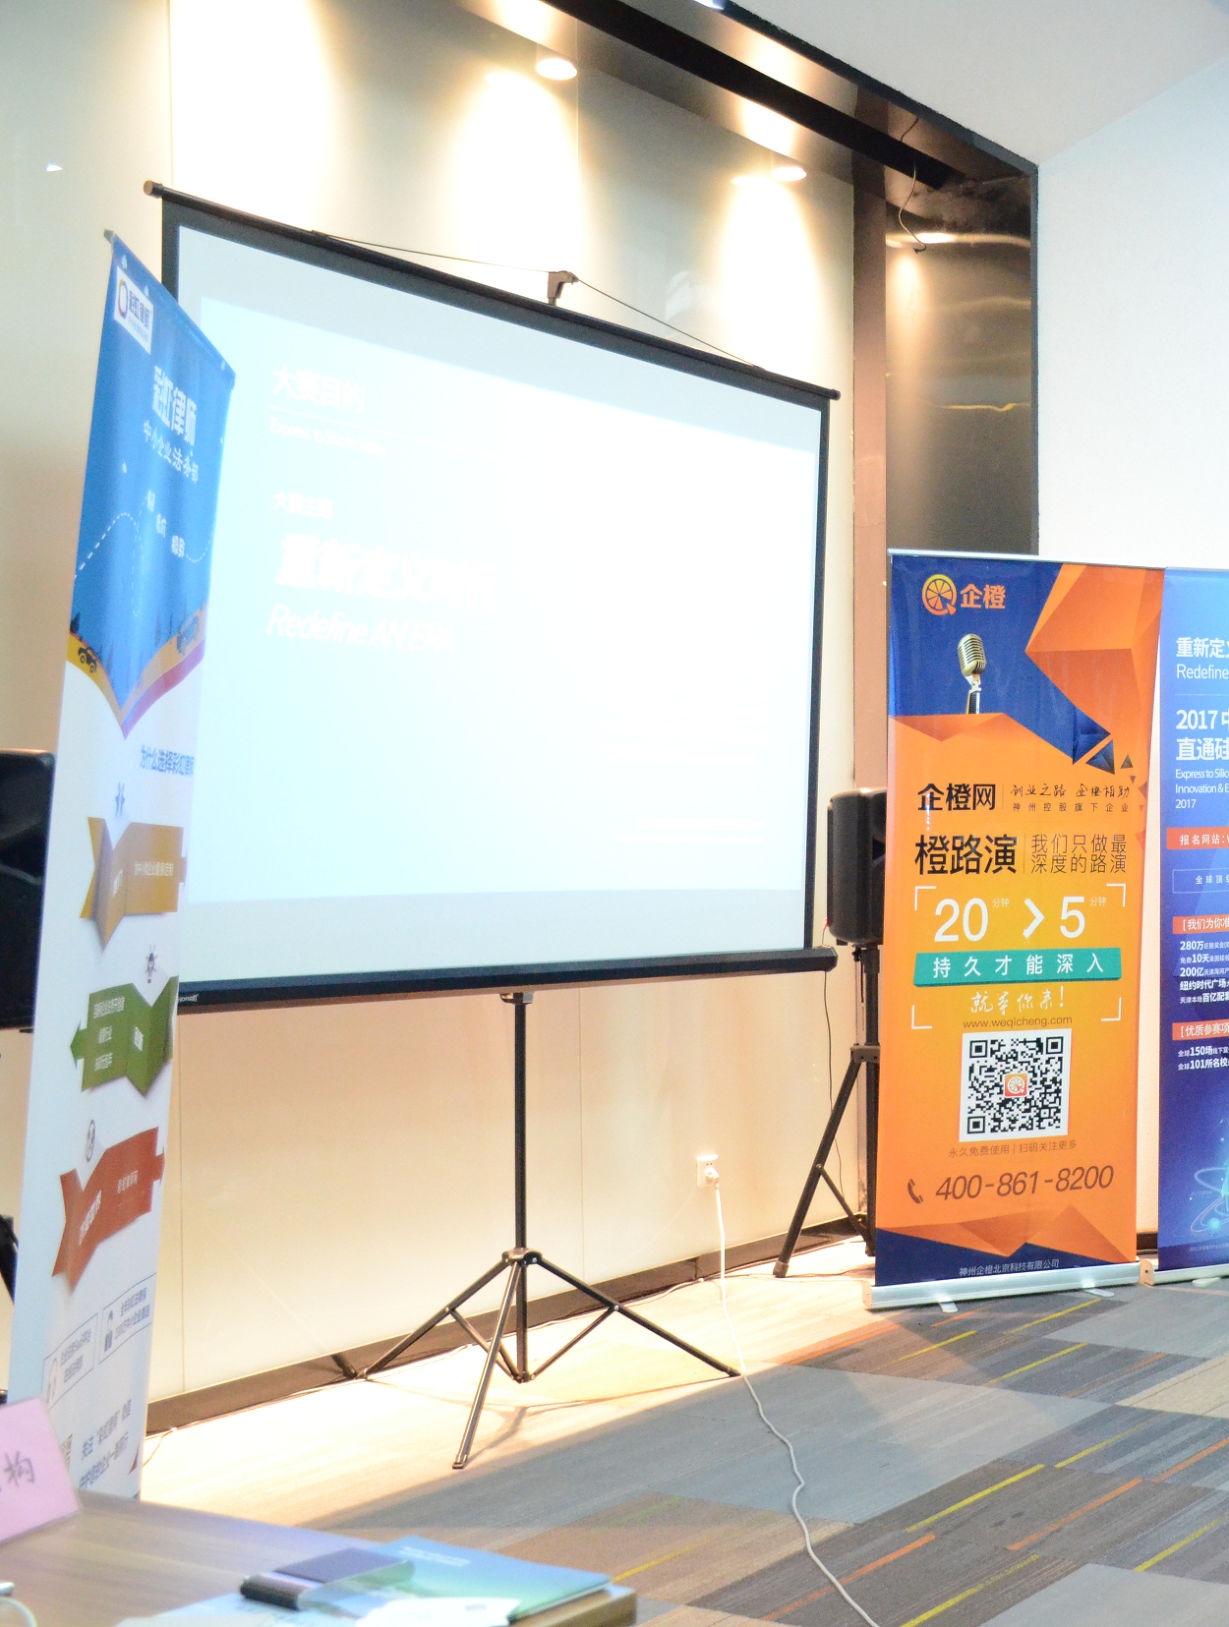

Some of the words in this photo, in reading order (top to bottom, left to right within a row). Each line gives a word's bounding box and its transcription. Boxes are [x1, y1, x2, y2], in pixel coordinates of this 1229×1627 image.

[960, 584, 1006, 610] 企橙
[266, 603, 368, 645] Redefine
[1176, 664, 1229, 680] Redefine
[1175, 768, 1206, 779] Express
[1206, 769, 1214, 778] to
[917, 783, 996, 811] 企橙网
[1175, 784, 1217, 794] Innovation
[1175, 799, 1197, 809] 2017
[914, 834, 1017, 875] 橙路演
[1031, 833, 1127, 853] 我们只做最
[1031, 854, 1127, 874] 深度的路演
[934, 897, 989, 942] 20
[1059, 896, 1086, 938] 5
[933, 954, 1104, 978] 持久才能深入
[962, 1015, 1073, 1029] www.weqicheng.com
[936, 1165, 1114, 1200] 400-861-8200
